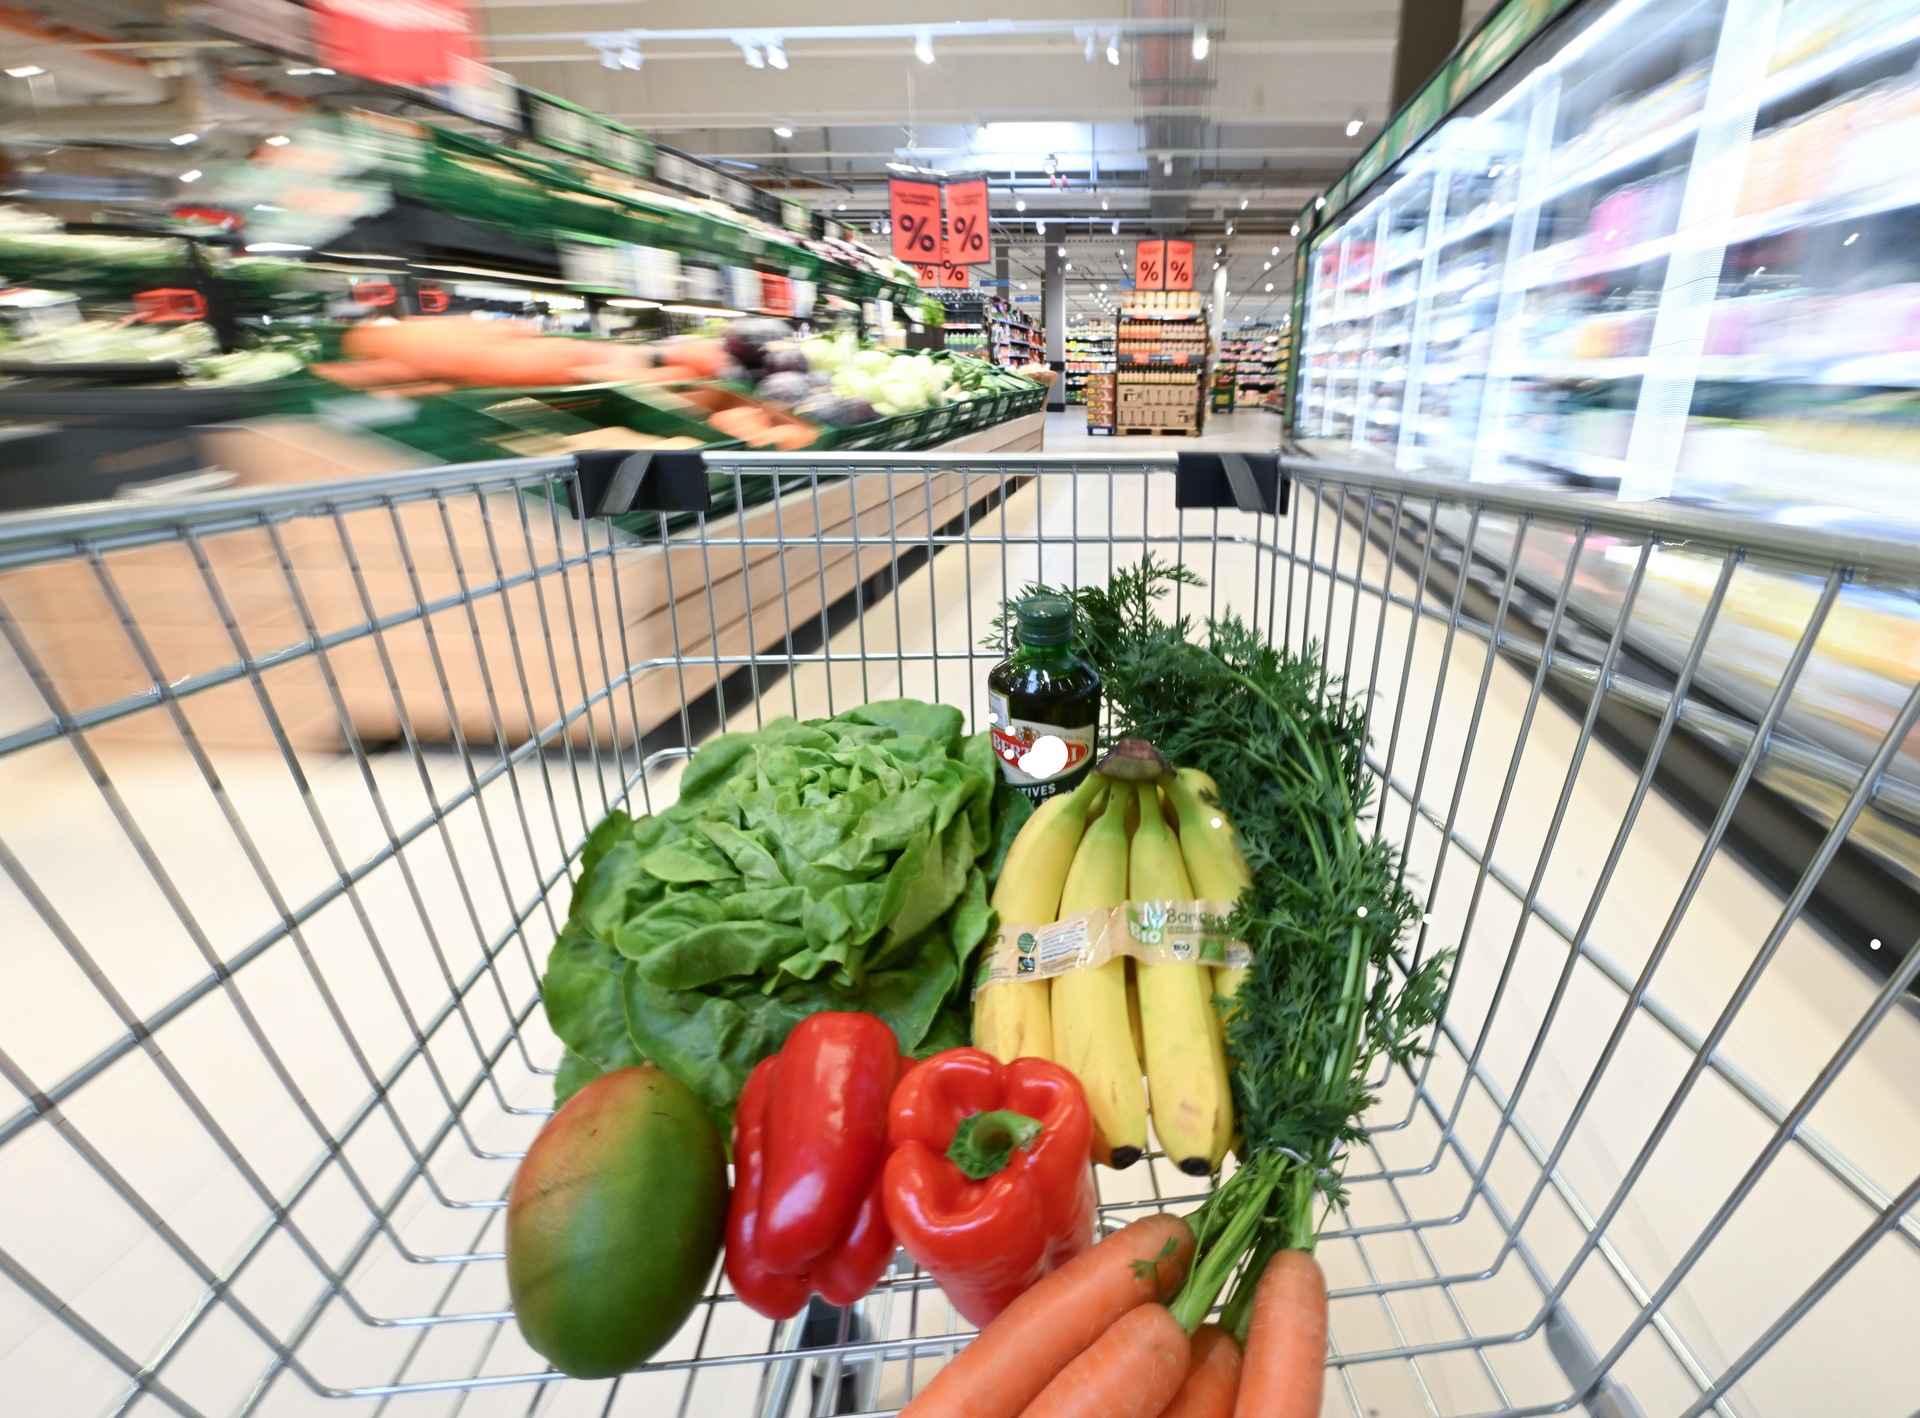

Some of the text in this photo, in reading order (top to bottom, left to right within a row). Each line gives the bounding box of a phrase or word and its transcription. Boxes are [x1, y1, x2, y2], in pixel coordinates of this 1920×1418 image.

[900, 214, 935, 252] %
[954, 214, 983, 252] %
[1141, 261, 1159, 282] %
[1170, 261, 1189, 282] %
[1016, 783, 1057, 798] TIVES
